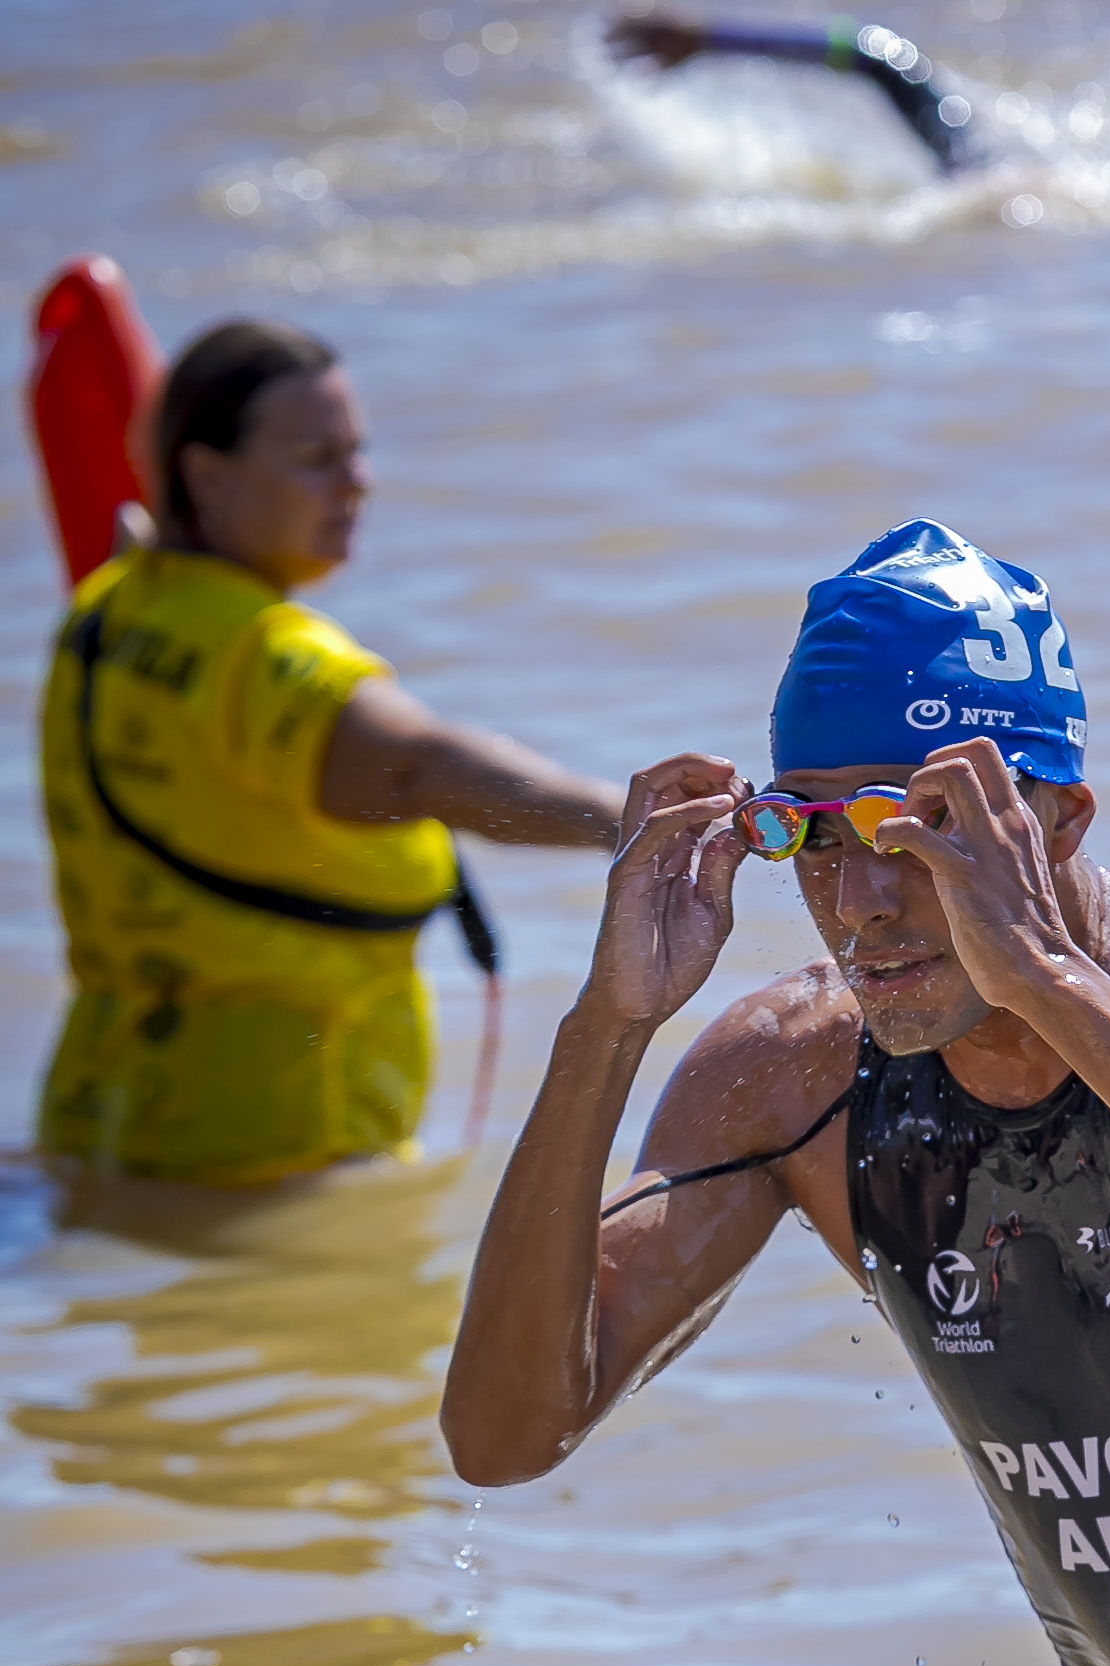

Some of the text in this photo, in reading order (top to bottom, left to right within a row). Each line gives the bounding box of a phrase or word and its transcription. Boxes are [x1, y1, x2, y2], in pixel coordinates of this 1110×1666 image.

[960, 707, 1015, 728] NTT
[936, 1320, 981, 1337] World
[931, 1336, 995, 1354] Triathlon
